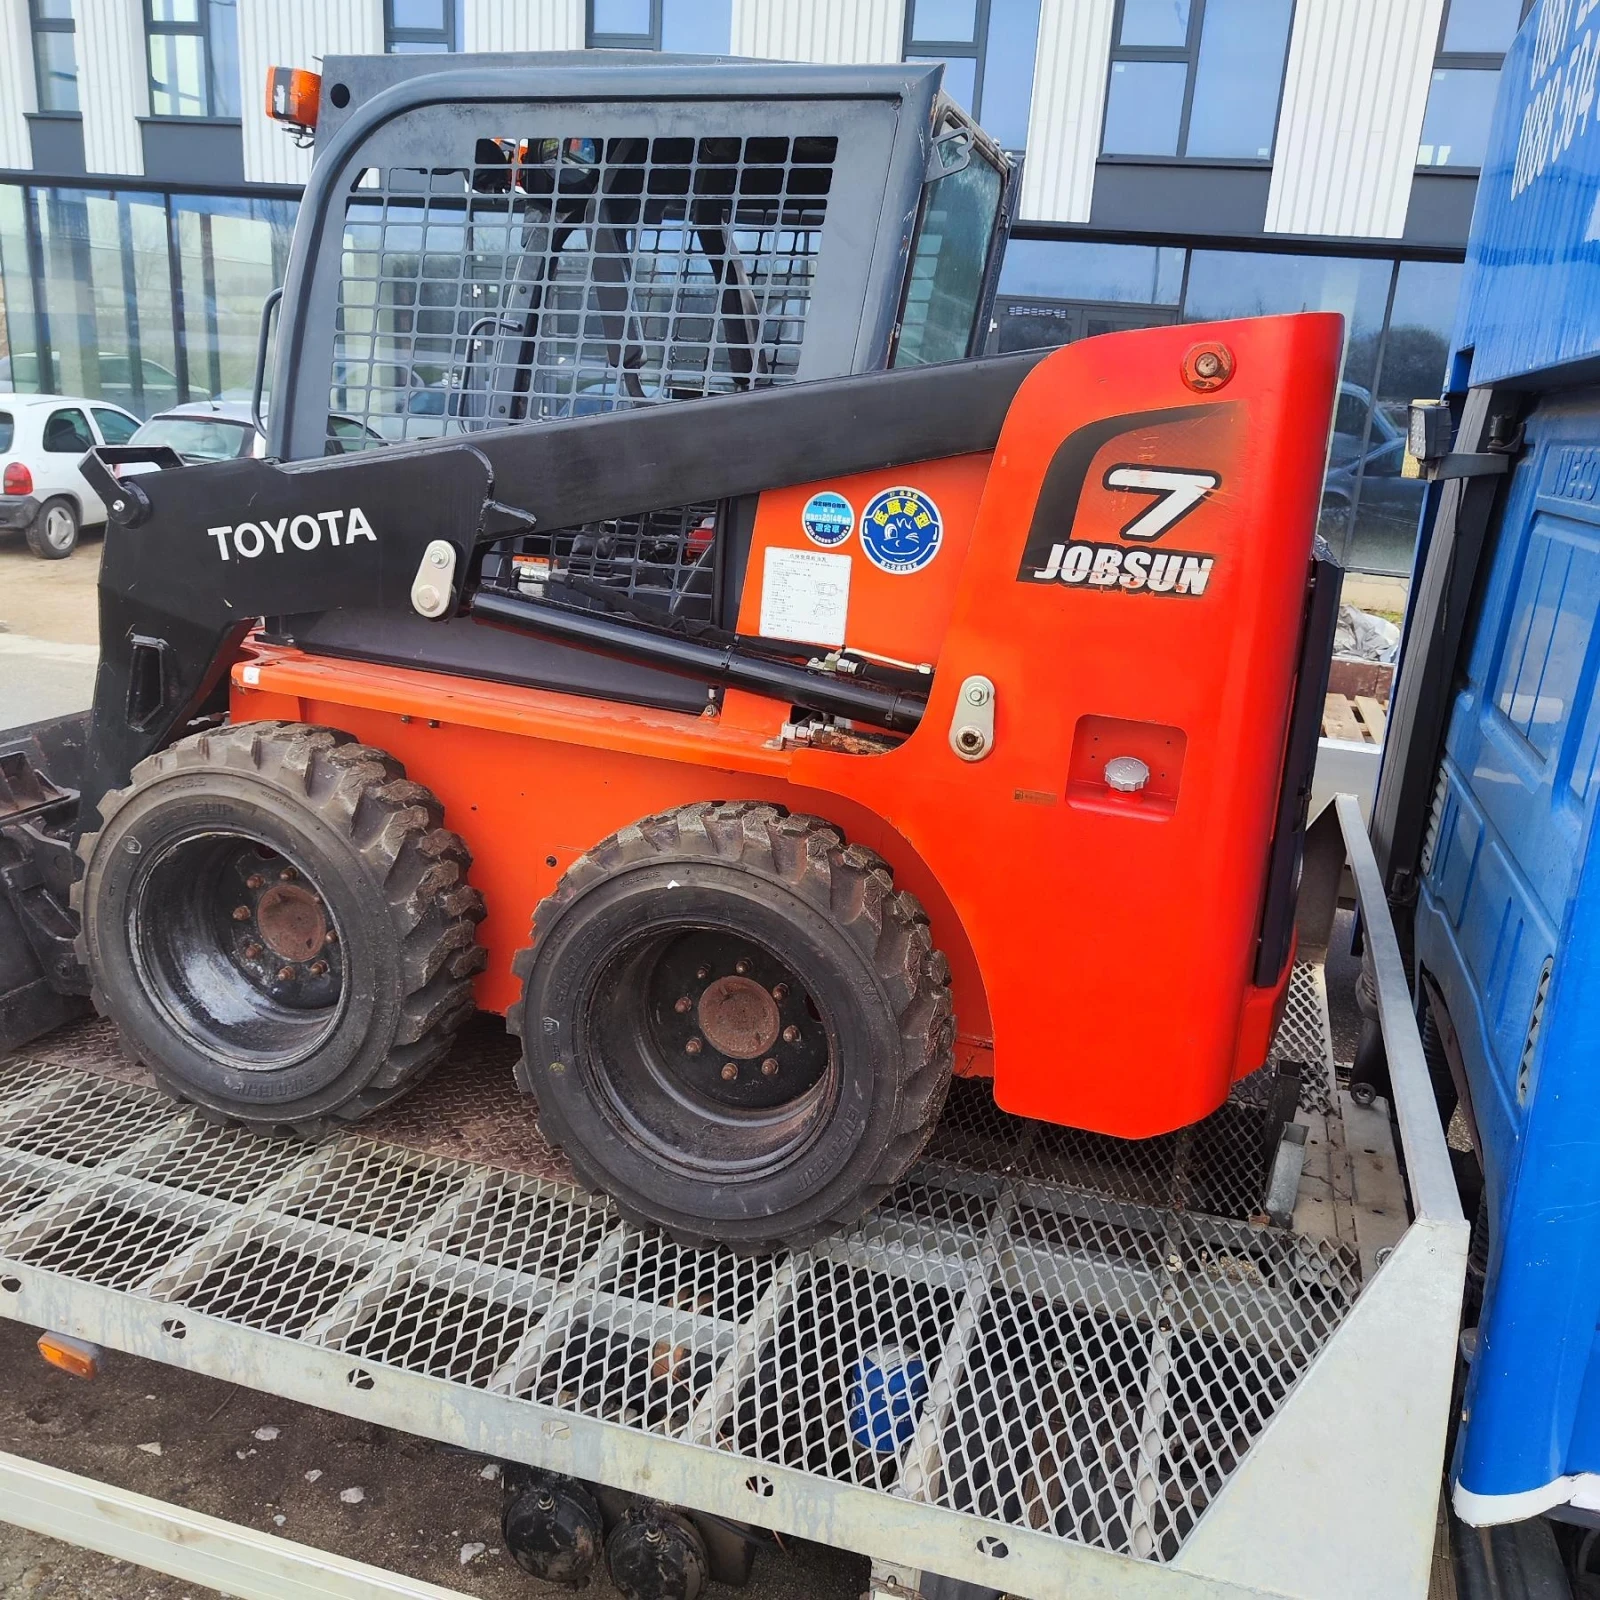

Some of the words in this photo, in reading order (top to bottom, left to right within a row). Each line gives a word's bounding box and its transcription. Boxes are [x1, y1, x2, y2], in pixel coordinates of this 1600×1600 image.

[1104, 464, 1220, 540] 7
[207, 507, 378, 561] TOYOTA
[1033, 542, 1215, 596] JOBSUN
